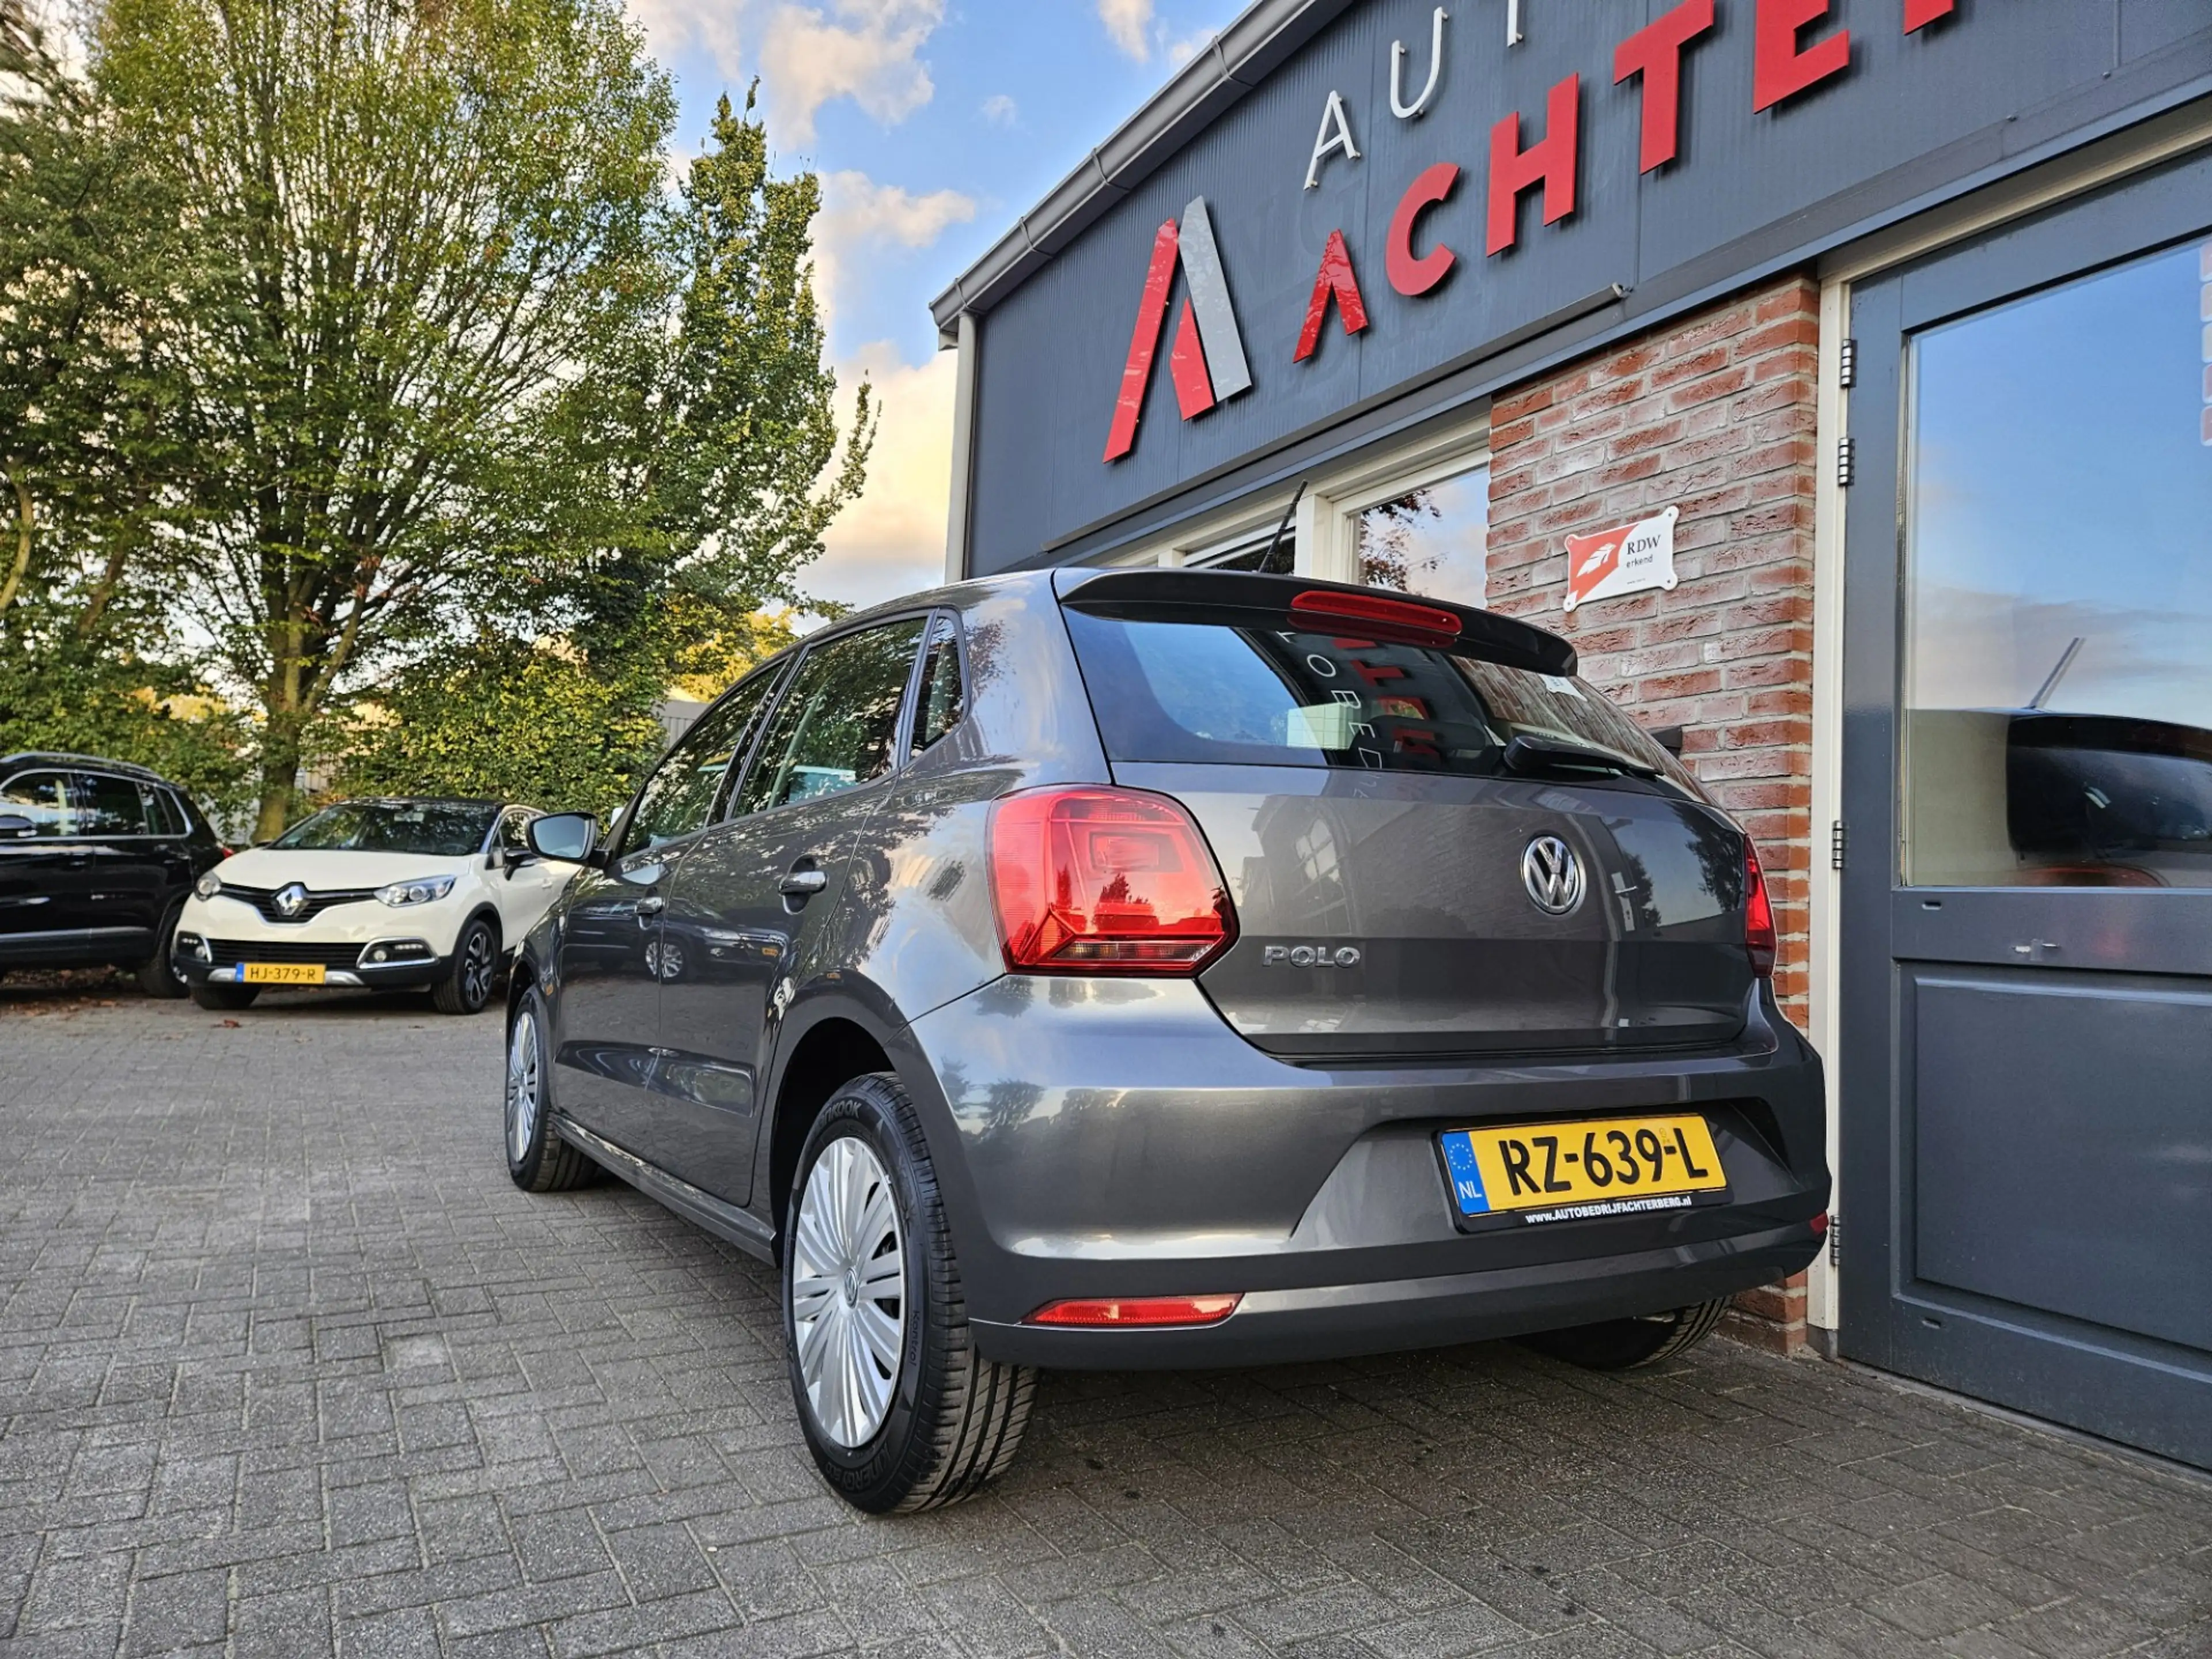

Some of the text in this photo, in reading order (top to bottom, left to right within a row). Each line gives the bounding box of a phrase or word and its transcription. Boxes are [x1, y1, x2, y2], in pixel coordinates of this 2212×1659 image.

[1293, 0, 1954, 363] ACHTE
[1627, 534, 1661, 555] RDW
[1626, 554, 1653, 569] erkend
[1263, 946, 1361, 968] POLO
[250, 967, 316, 980] HJ-379-R
[1498, 1127, 1709, 1195] RZ-639-L
[1459, 1181, 1482, 1199] NL
[1525, 1196, 1692, 1224] www.AUTOBEDRIJFACHTERBERG.nl
[910, 1309, 920, 1366] Kontrol
